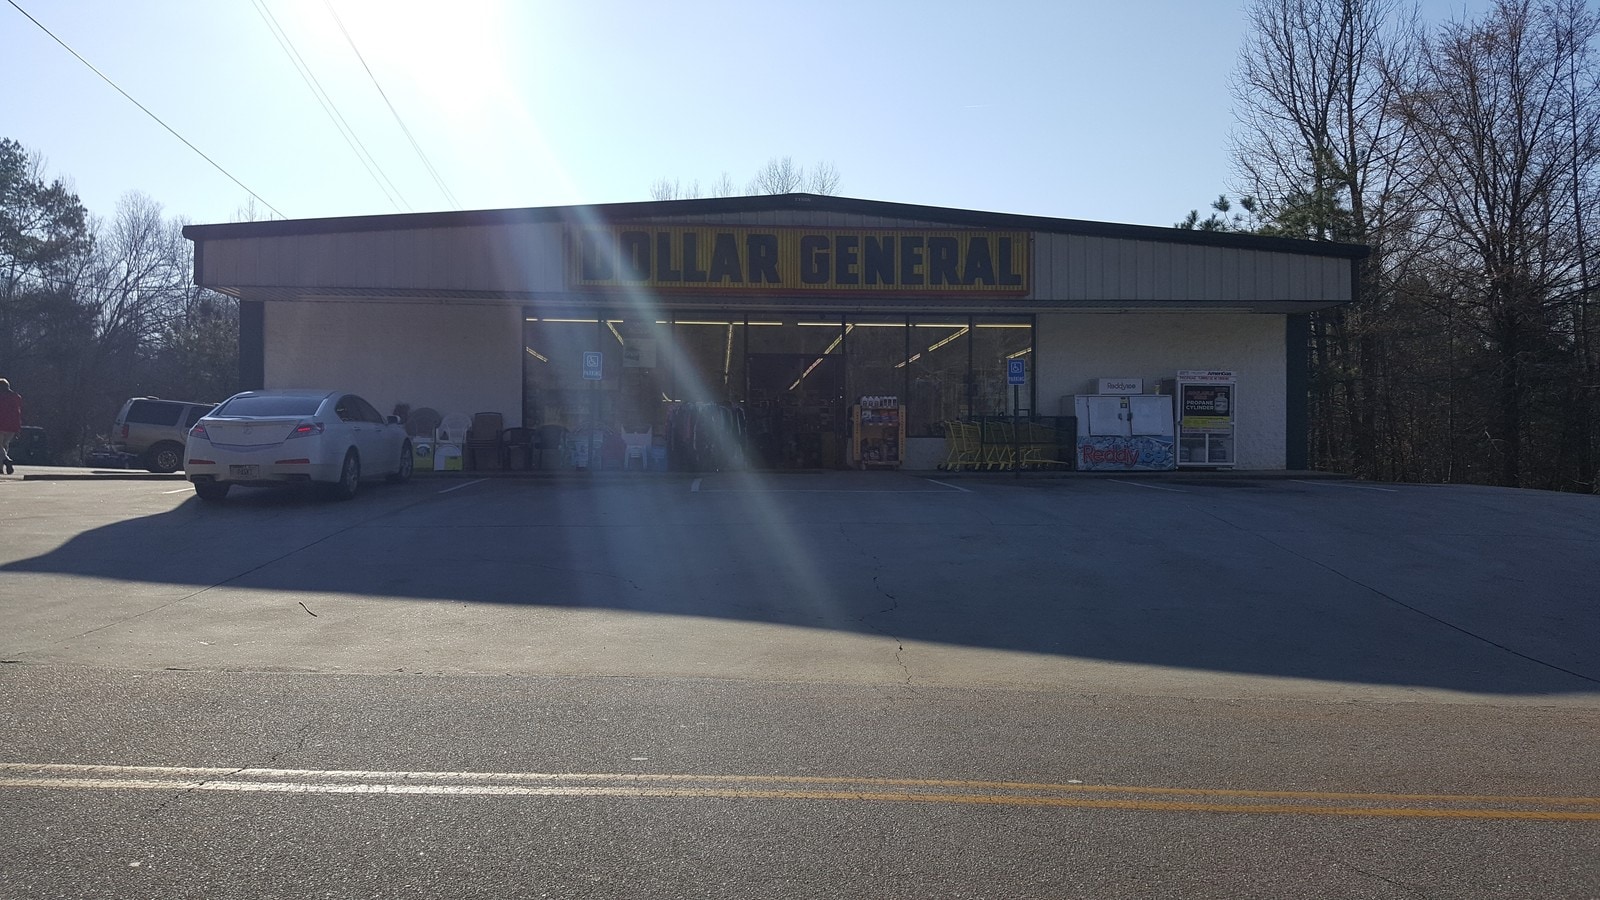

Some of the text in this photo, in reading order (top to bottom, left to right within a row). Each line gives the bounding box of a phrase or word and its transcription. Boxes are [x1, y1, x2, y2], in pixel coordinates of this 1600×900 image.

[582, 230, 1022, 286] DOLLAR GENERAL
[1083, 444, 1139, 468] Reddy
